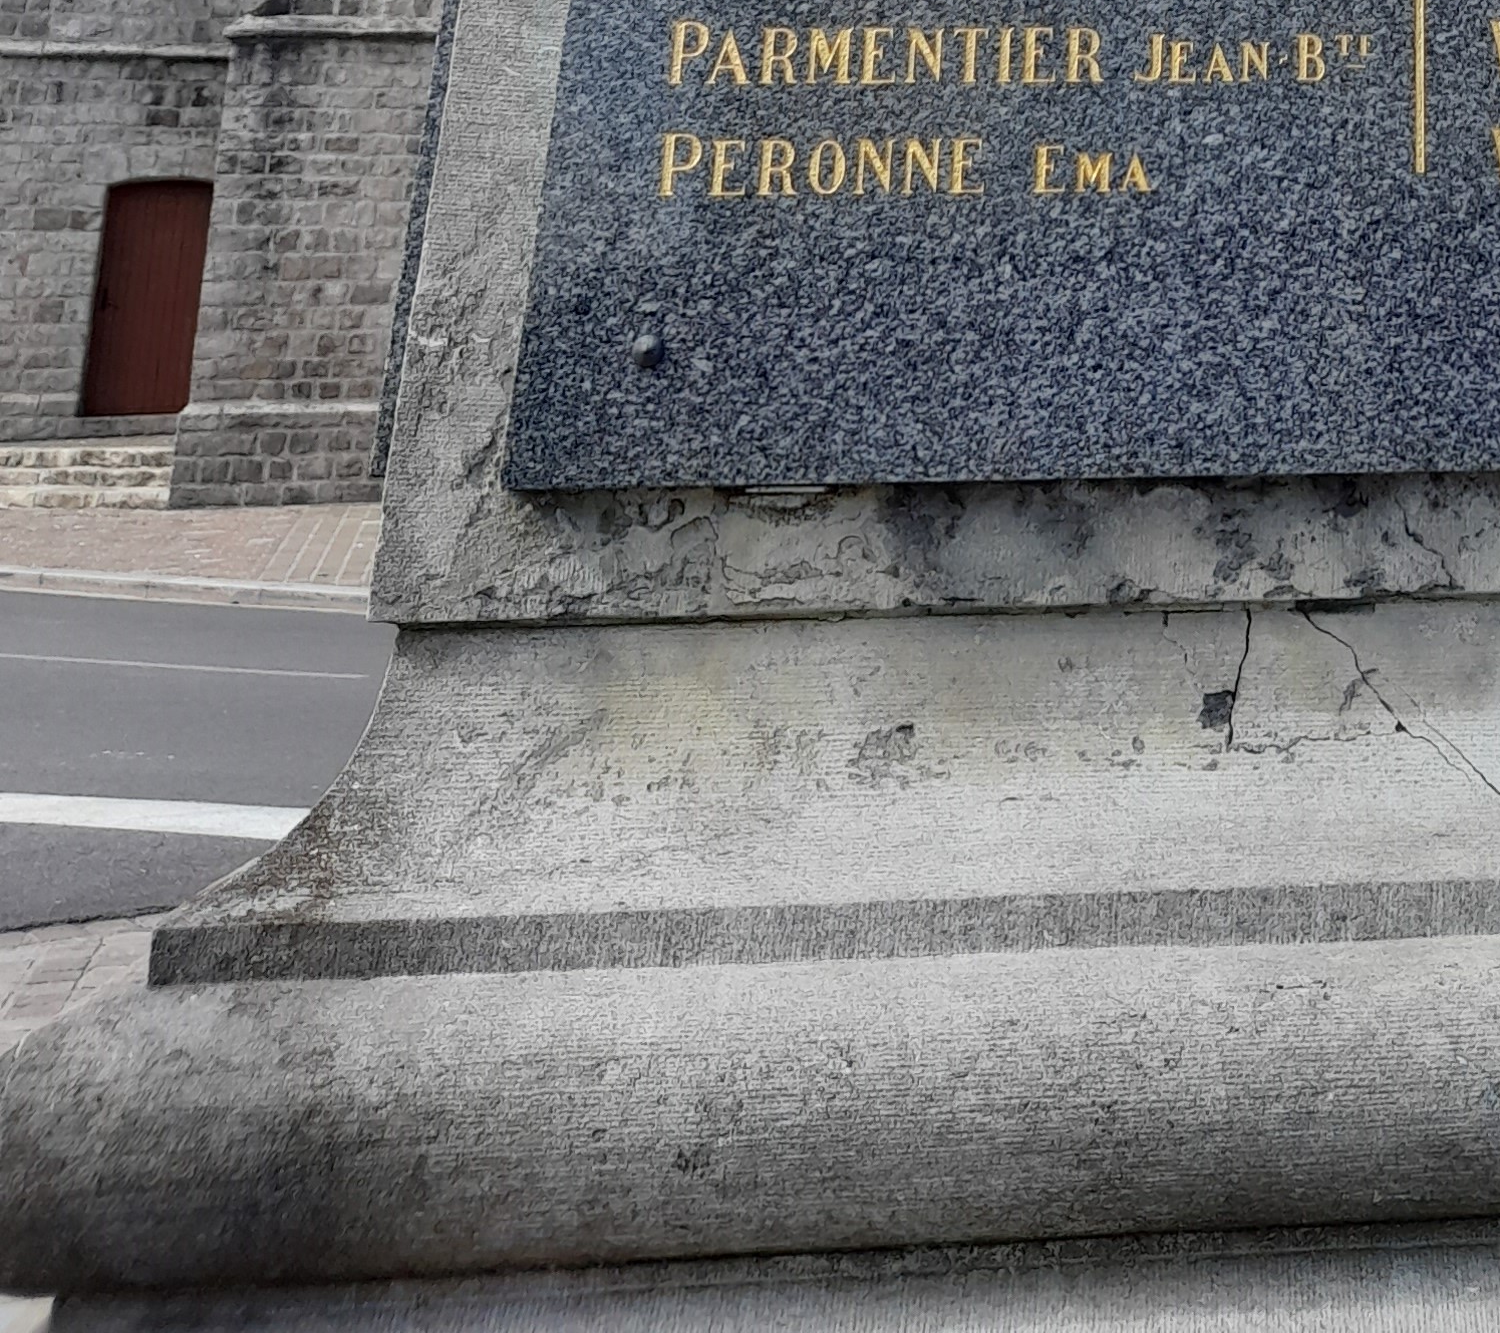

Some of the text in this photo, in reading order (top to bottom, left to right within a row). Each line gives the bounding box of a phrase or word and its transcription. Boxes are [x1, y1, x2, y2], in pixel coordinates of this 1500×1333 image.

[666, 21, 1104, 85] PARMENTIER
[656, 132, 1152, 197] PERONNE EMA
